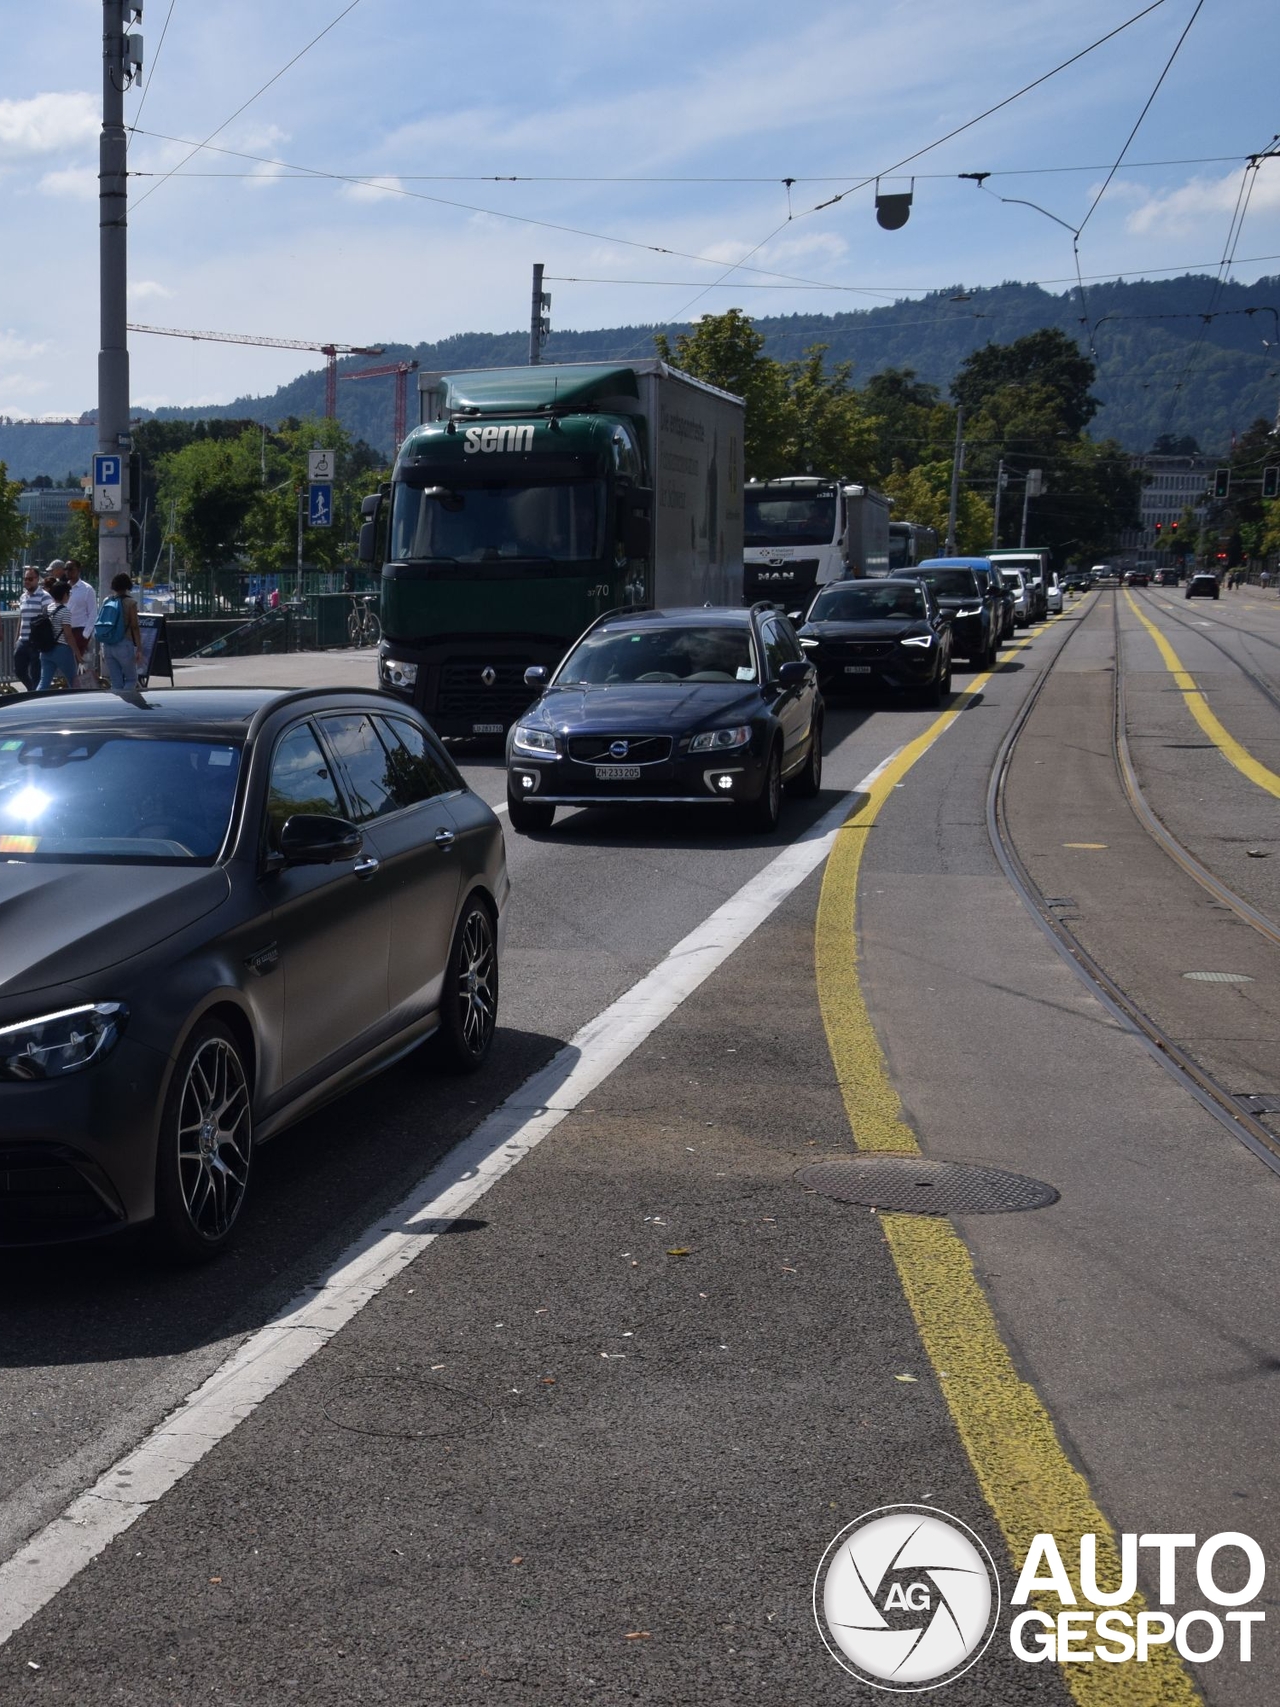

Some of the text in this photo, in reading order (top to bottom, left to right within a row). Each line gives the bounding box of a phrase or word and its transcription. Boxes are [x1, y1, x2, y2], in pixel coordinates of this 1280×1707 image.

[463, 424, 535, 454] senn
[101, 460, 115, 482] P
[757, 571, 795, 581] MAN
